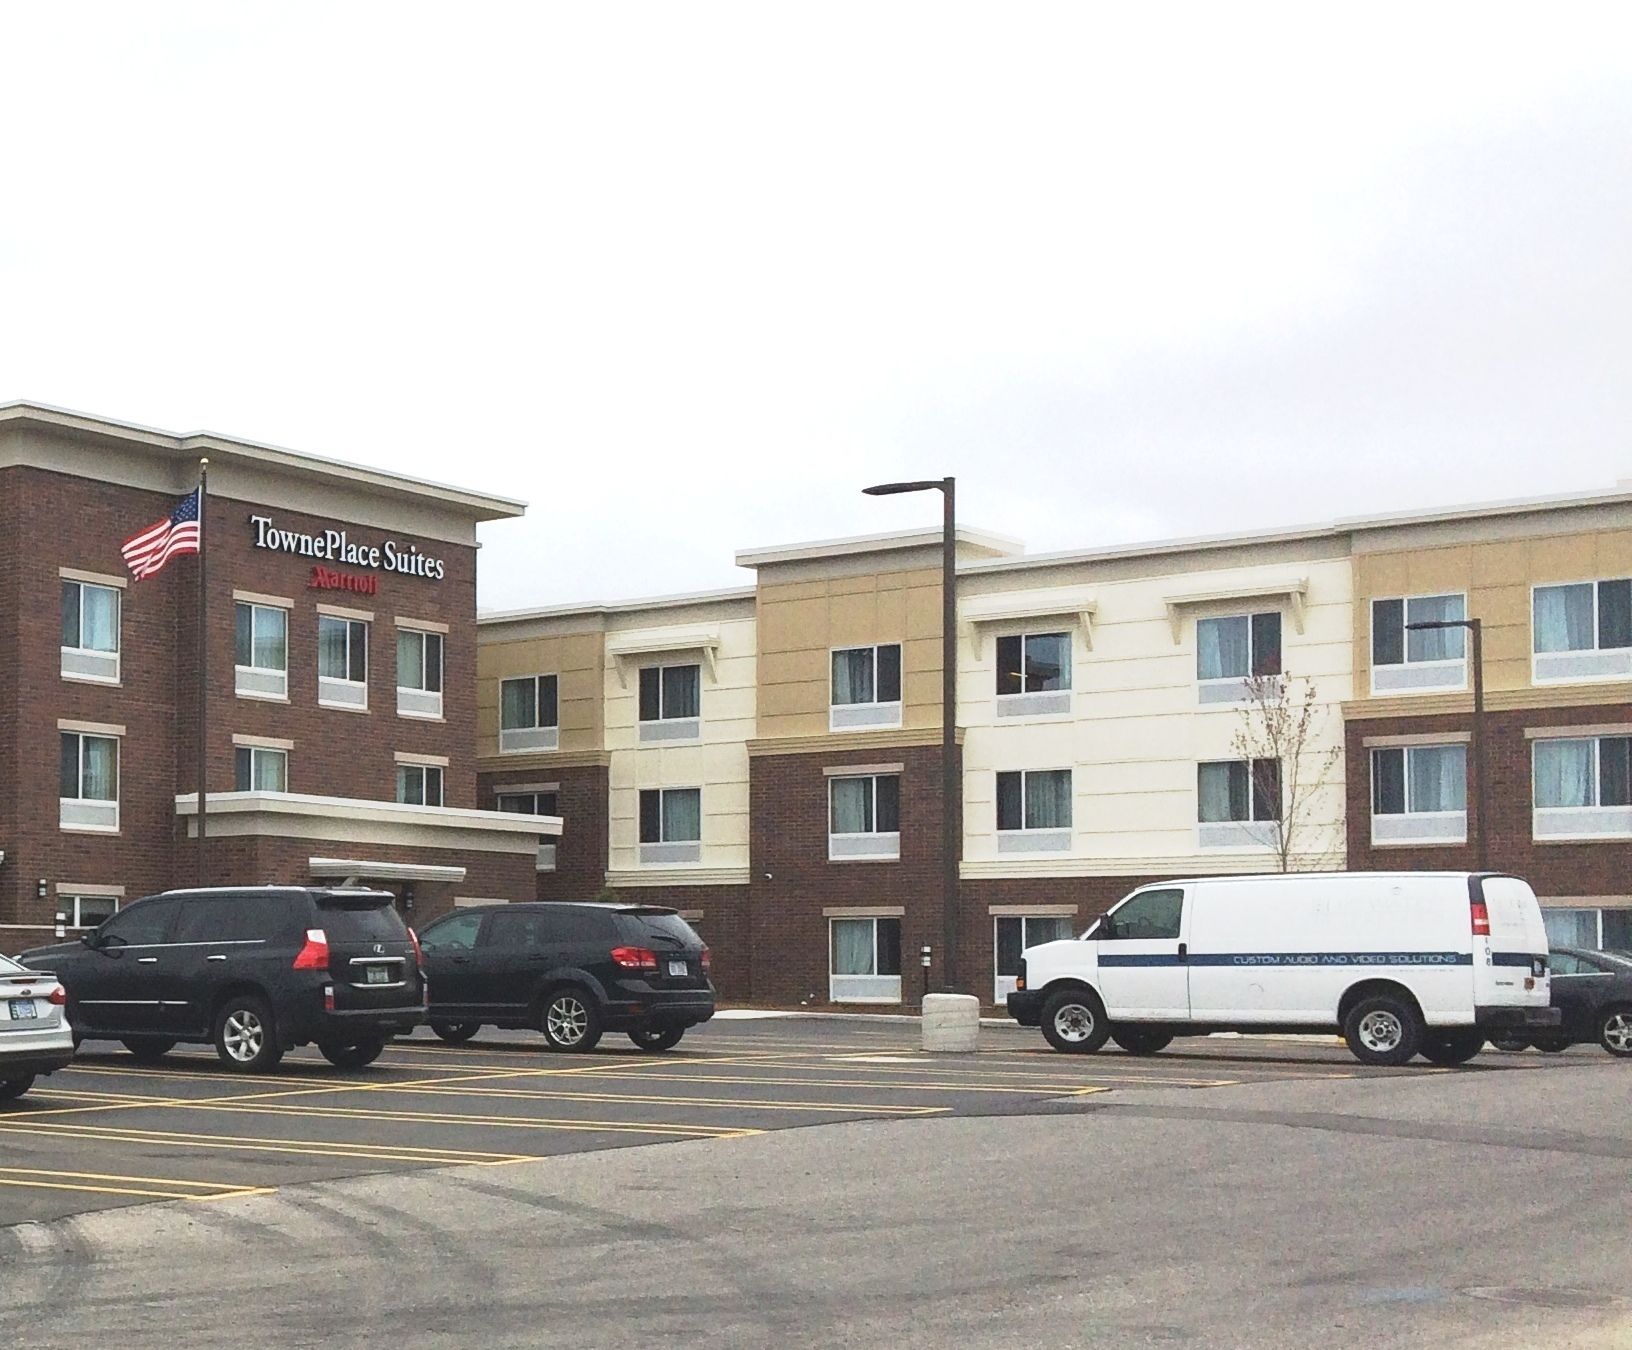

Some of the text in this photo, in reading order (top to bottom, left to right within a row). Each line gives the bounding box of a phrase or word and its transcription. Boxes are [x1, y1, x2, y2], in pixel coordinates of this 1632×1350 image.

[251, 515, 444, 580] TownePlace Suites
[1233, 954, 1457, 965] CUSTOM AUDIO AND VIDEO SOLUTIONS
